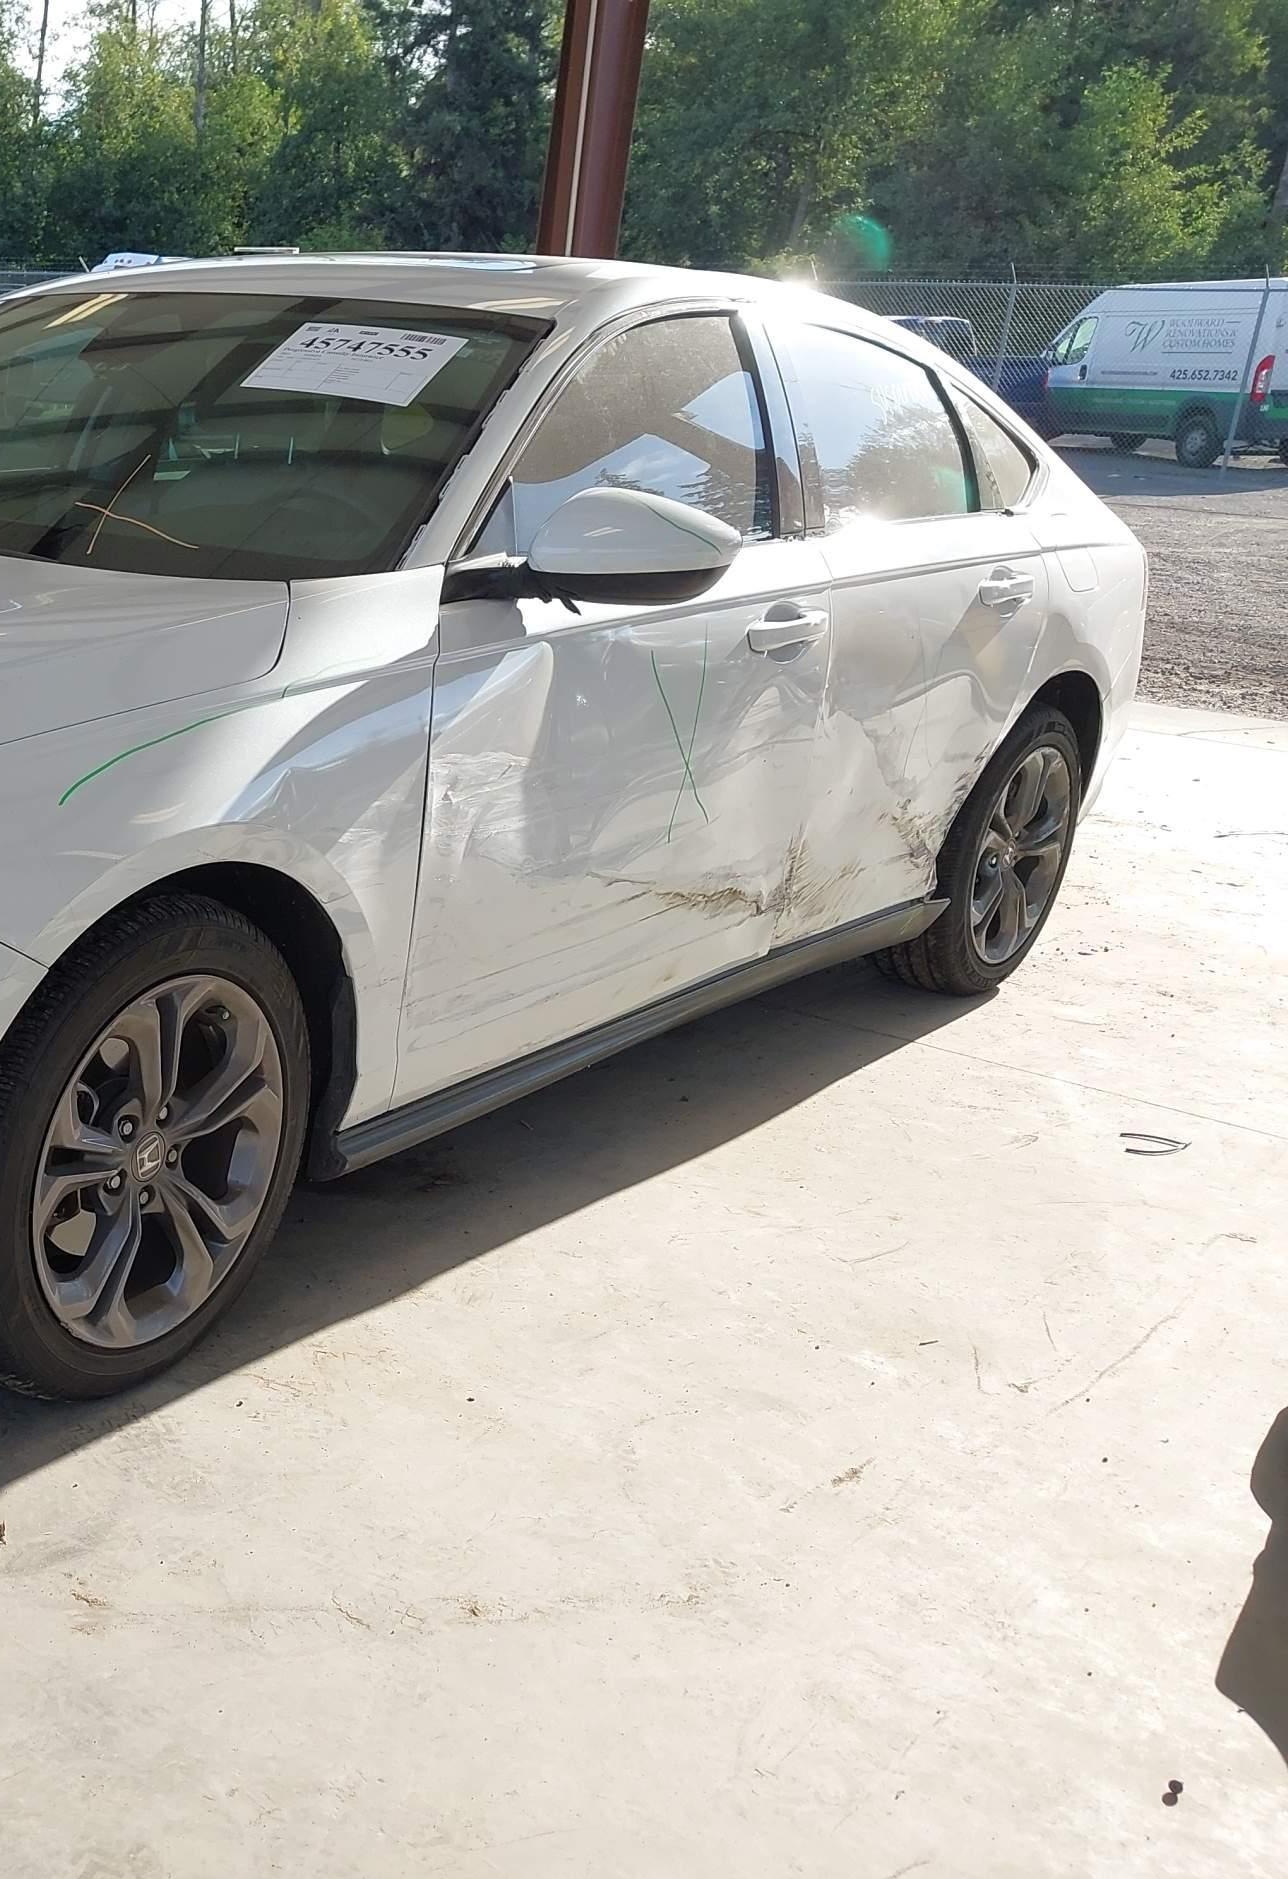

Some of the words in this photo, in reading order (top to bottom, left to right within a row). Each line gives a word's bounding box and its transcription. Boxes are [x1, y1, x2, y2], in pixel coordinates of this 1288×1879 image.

[299, 336, 433, 361] 45747555
[1202, 338, 1236, 348] HOMES
[1169, 368, 1239, 382] 425.652.7342
